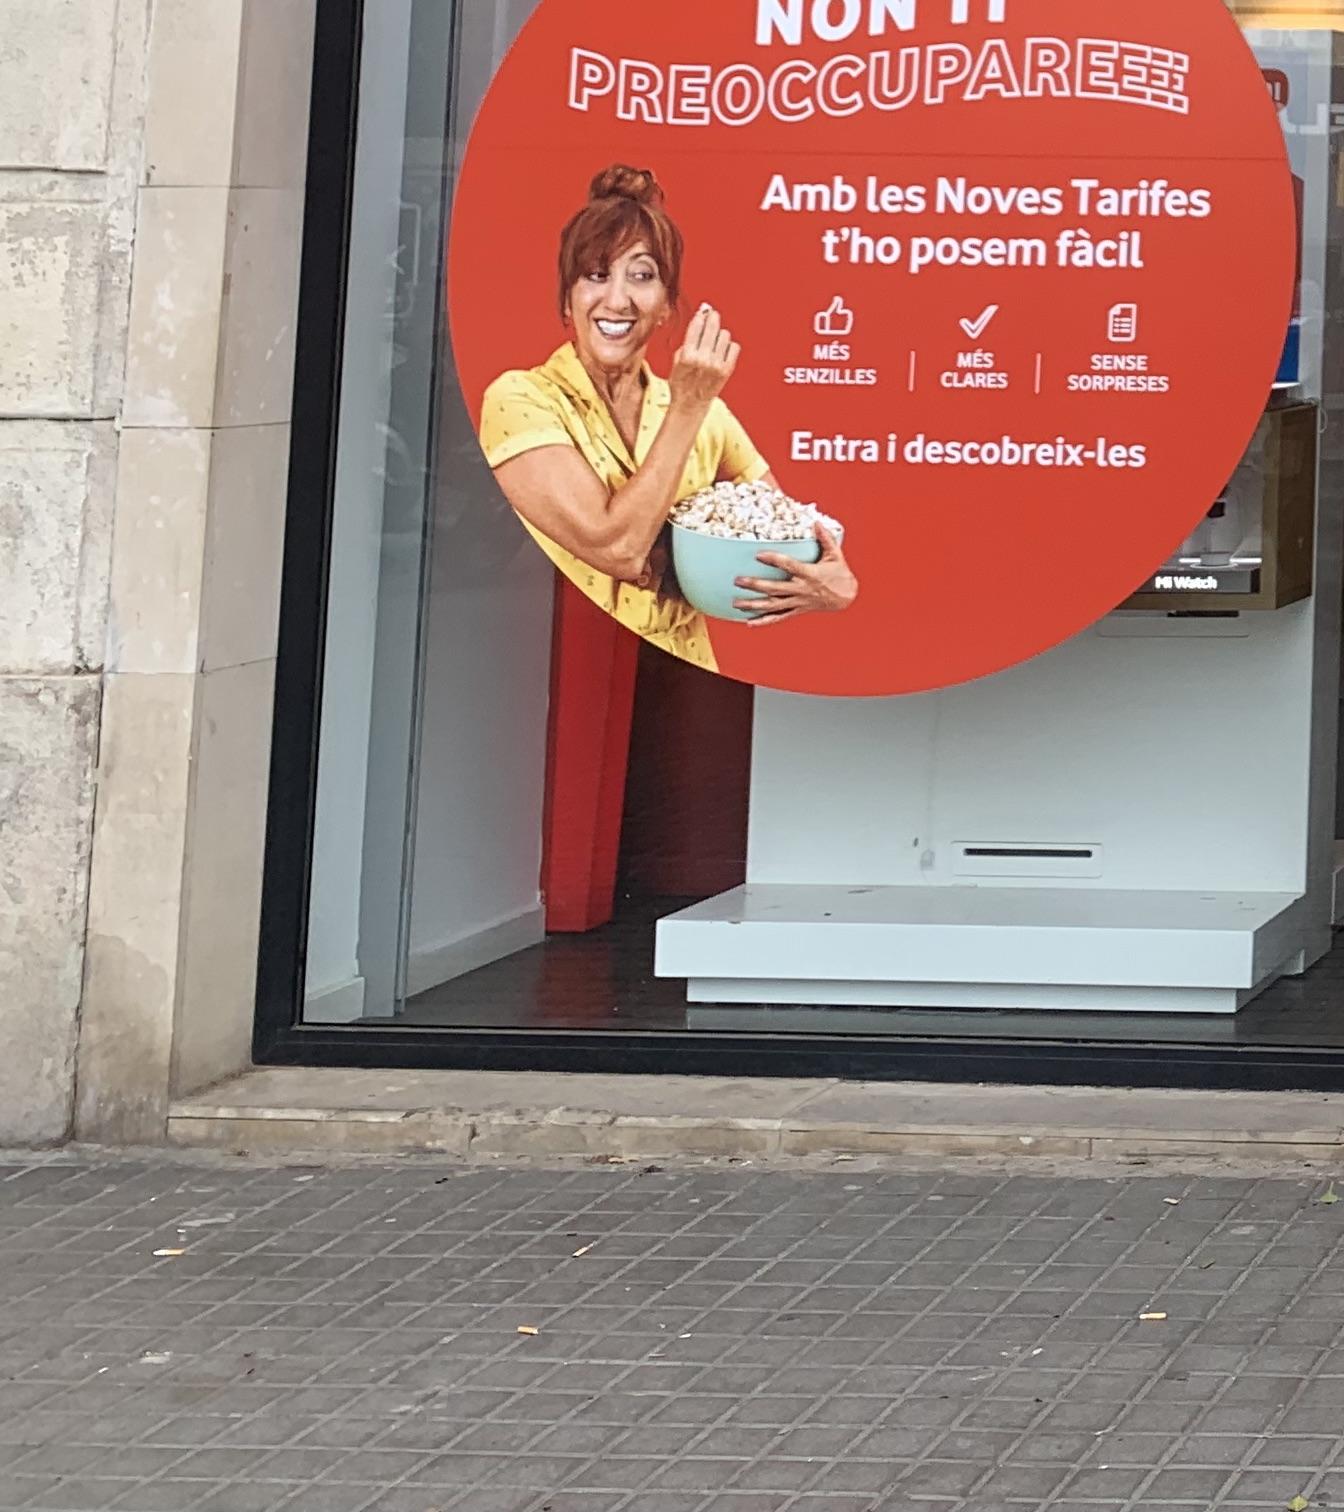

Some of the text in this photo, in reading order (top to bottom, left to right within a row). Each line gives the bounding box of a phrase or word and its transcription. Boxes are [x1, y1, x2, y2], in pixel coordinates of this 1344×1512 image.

[760, 175, 1211, 218] Amb les Noves Tarifes
[909, 239, 1047, 273] posem
[1055, 230, 1144, 269] fàcil
[813, 340, 850, 361] MÉS
[957, 349, 994, 369] MÉS
[1091, 354, 1148, 372] SENSE
[784, 367, 877, 385] SENZILLES
[941, 371, 1008, 389] CLARES
[1067, 375, 1169, 392] SORPRESES
[791, 431, 1147, 468] Entra i descobreix-les
[1155, 576, 1218, 589] Mi Watch
